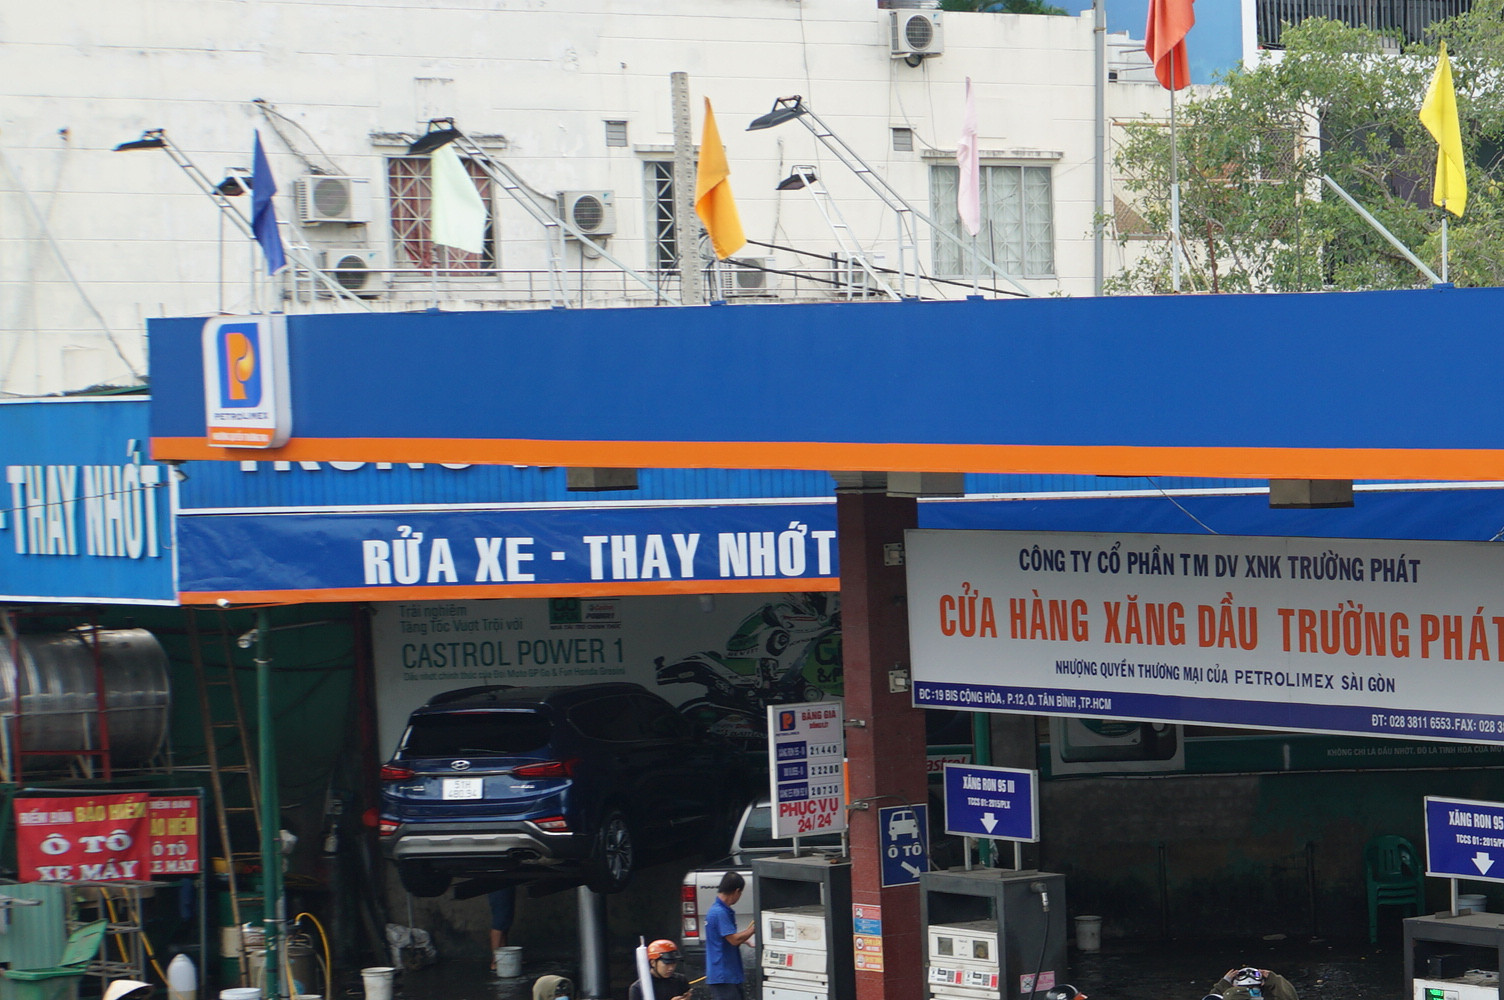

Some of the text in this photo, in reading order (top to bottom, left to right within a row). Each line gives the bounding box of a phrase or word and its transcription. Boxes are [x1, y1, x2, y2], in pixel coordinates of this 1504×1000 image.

[7, 439, 160, 559] THAY NHỚT
[362, 525, 458, 585] RỬA
[475, 537, 535, 583] XE
[583, 533, 700, 581] THAY
[718, 520, 836, 577] NHỚT
[1019, 541, 1421, 583] CÔNG TY CỔ PHẦN TM DV XNK TRƯỜNG PHÁT
[939, 581, 998, 638] CỬA
[1009, 589, 1089, 642] HÀNG
[1104, 594, 1186, 646] XĂNG
[1197, 592, 1258, 651] DẦU
[1277, 600, 1410, 659] TRƯỜNG
[403, 638, 623, 668] CASTROL POWER 1
[1055, 657, 1396, 693] NHƯỢNG QUYỀN THƯƠNG MẠI CỦA PETROLIMEX SÀI GÒN
[962, 774, 981, 791] XĂNG
[779, 798, 839, 819] PHỤC VỤ
[1448, 808, 1472, 828] XĂNG
[1473, 813, 1492, 830] RON
[1493, 814, 1504, 831] 95
[798, 813, 831, 833] 24/24
[40, 829, 132, 855] Ô TÔ
[888, 842, 922, 859] Ô TÔ
[36, 858, 139, 881] XE MÁY
